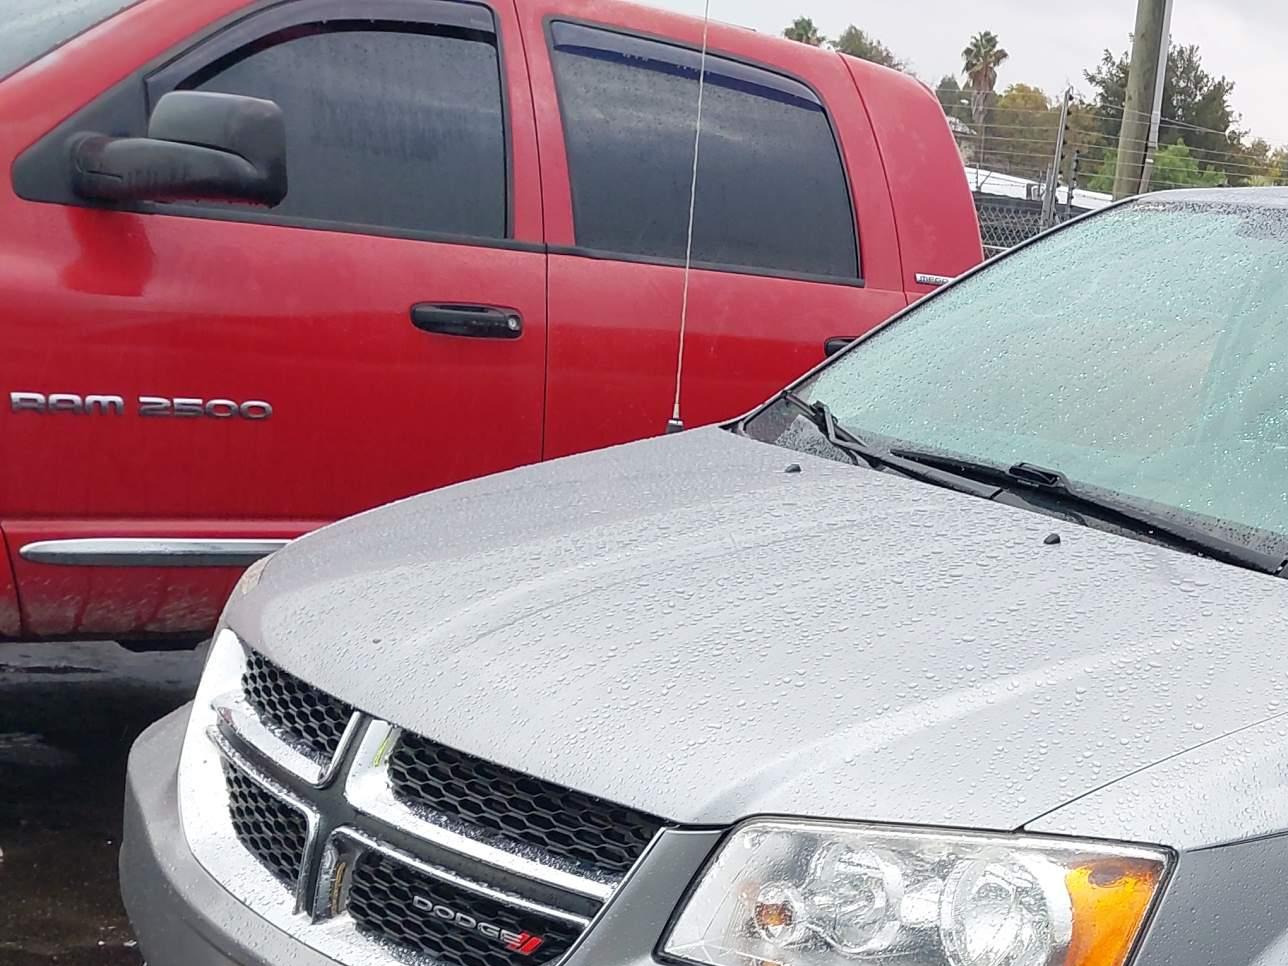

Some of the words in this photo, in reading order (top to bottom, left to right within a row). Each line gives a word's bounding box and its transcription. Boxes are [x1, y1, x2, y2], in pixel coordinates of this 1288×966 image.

[10, 392, 124, 416] RAM
[138, 396, 273, 419] 2500
[413, 895, 522, 947] DODGE
